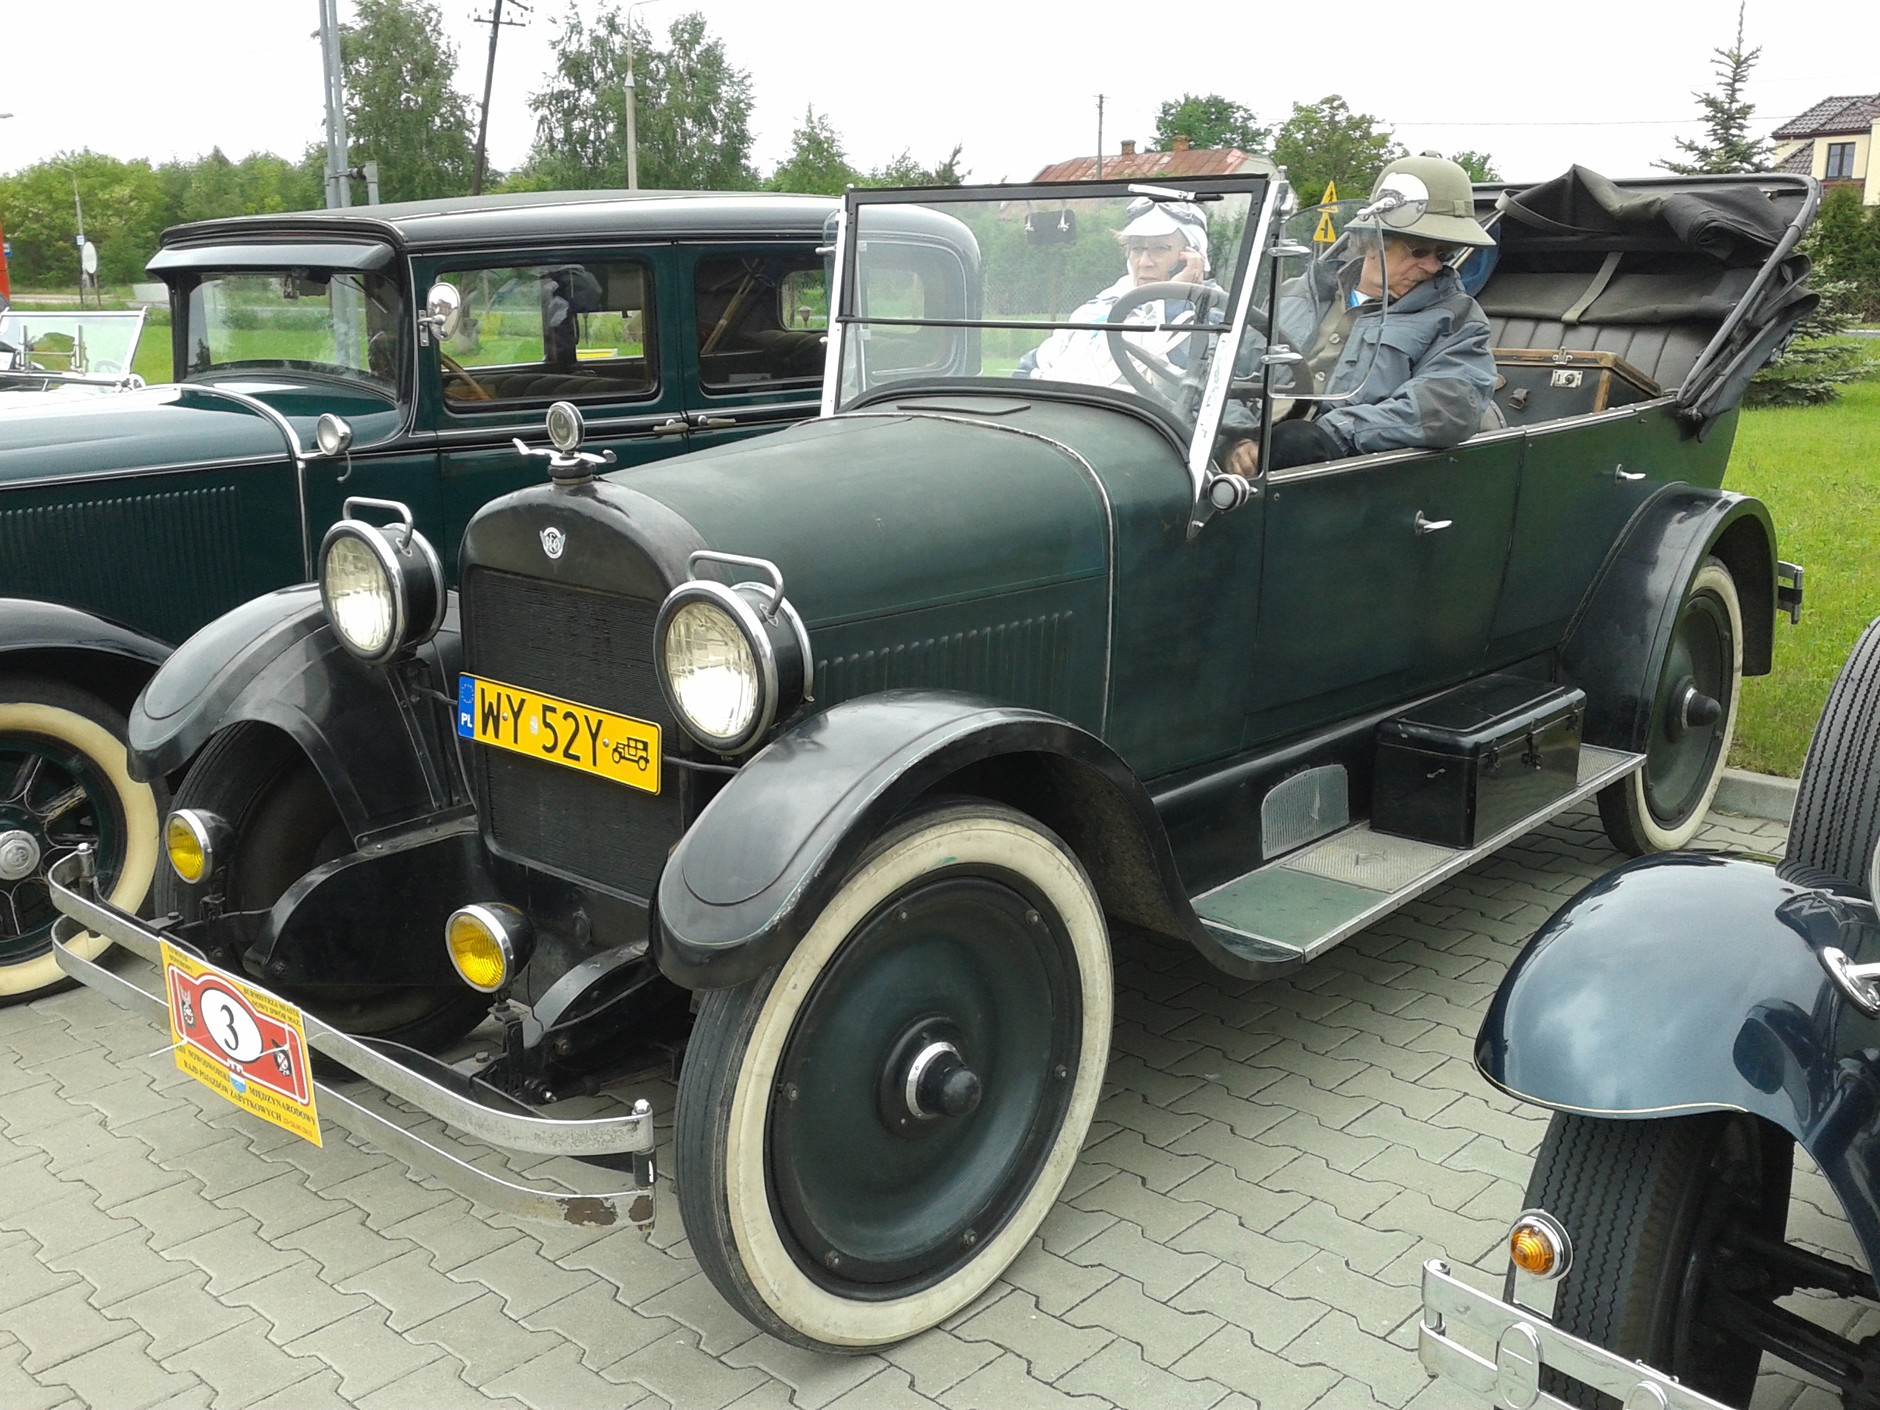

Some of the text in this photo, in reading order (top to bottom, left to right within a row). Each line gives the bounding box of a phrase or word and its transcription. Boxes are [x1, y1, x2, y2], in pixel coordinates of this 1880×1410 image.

[461, 712, 473, 728] PL
[480, 687, 603, 767] WY 52Y
[220, 1004, 239, 1051] 3
[229, 1089, 282, 1122] ZABYTKOWYCH
[248, 1086, 316, 1126] MIĘDZYNARODOWY
